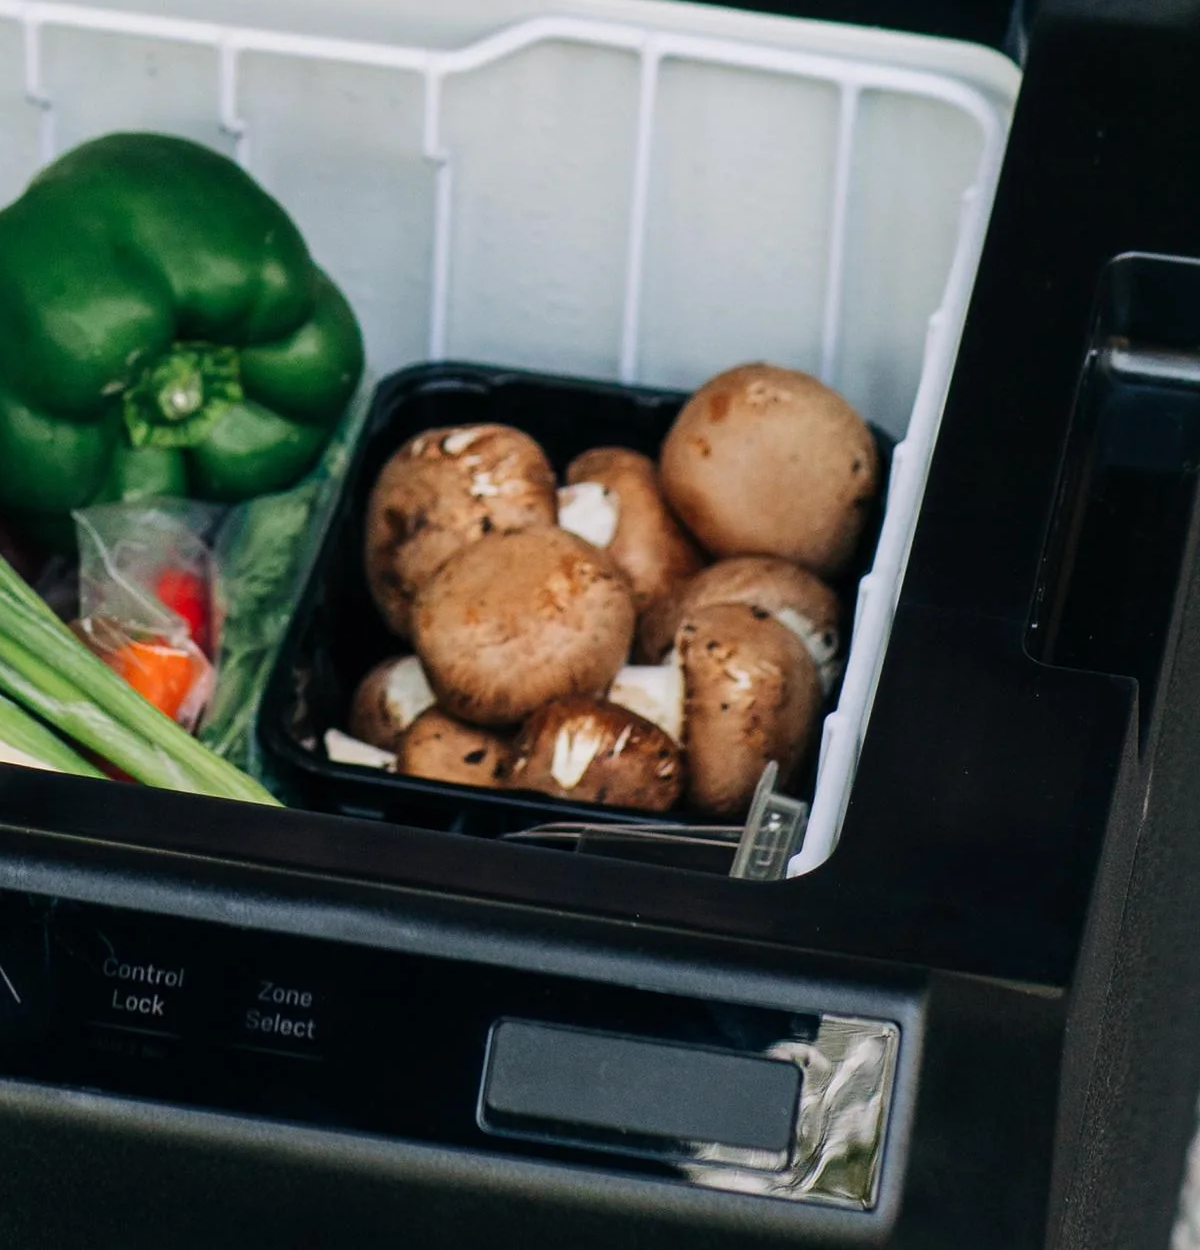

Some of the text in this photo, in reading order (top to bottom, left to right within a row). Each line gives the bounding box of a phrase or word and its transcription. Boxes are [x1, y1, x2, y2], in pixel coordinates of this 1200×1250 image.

[103, 957, 185, 988] Control
[112, 989, 165, 1016] Lock
[258, 980, 313, 1008] Zone
[246, 1010, 315, 1040] Select
